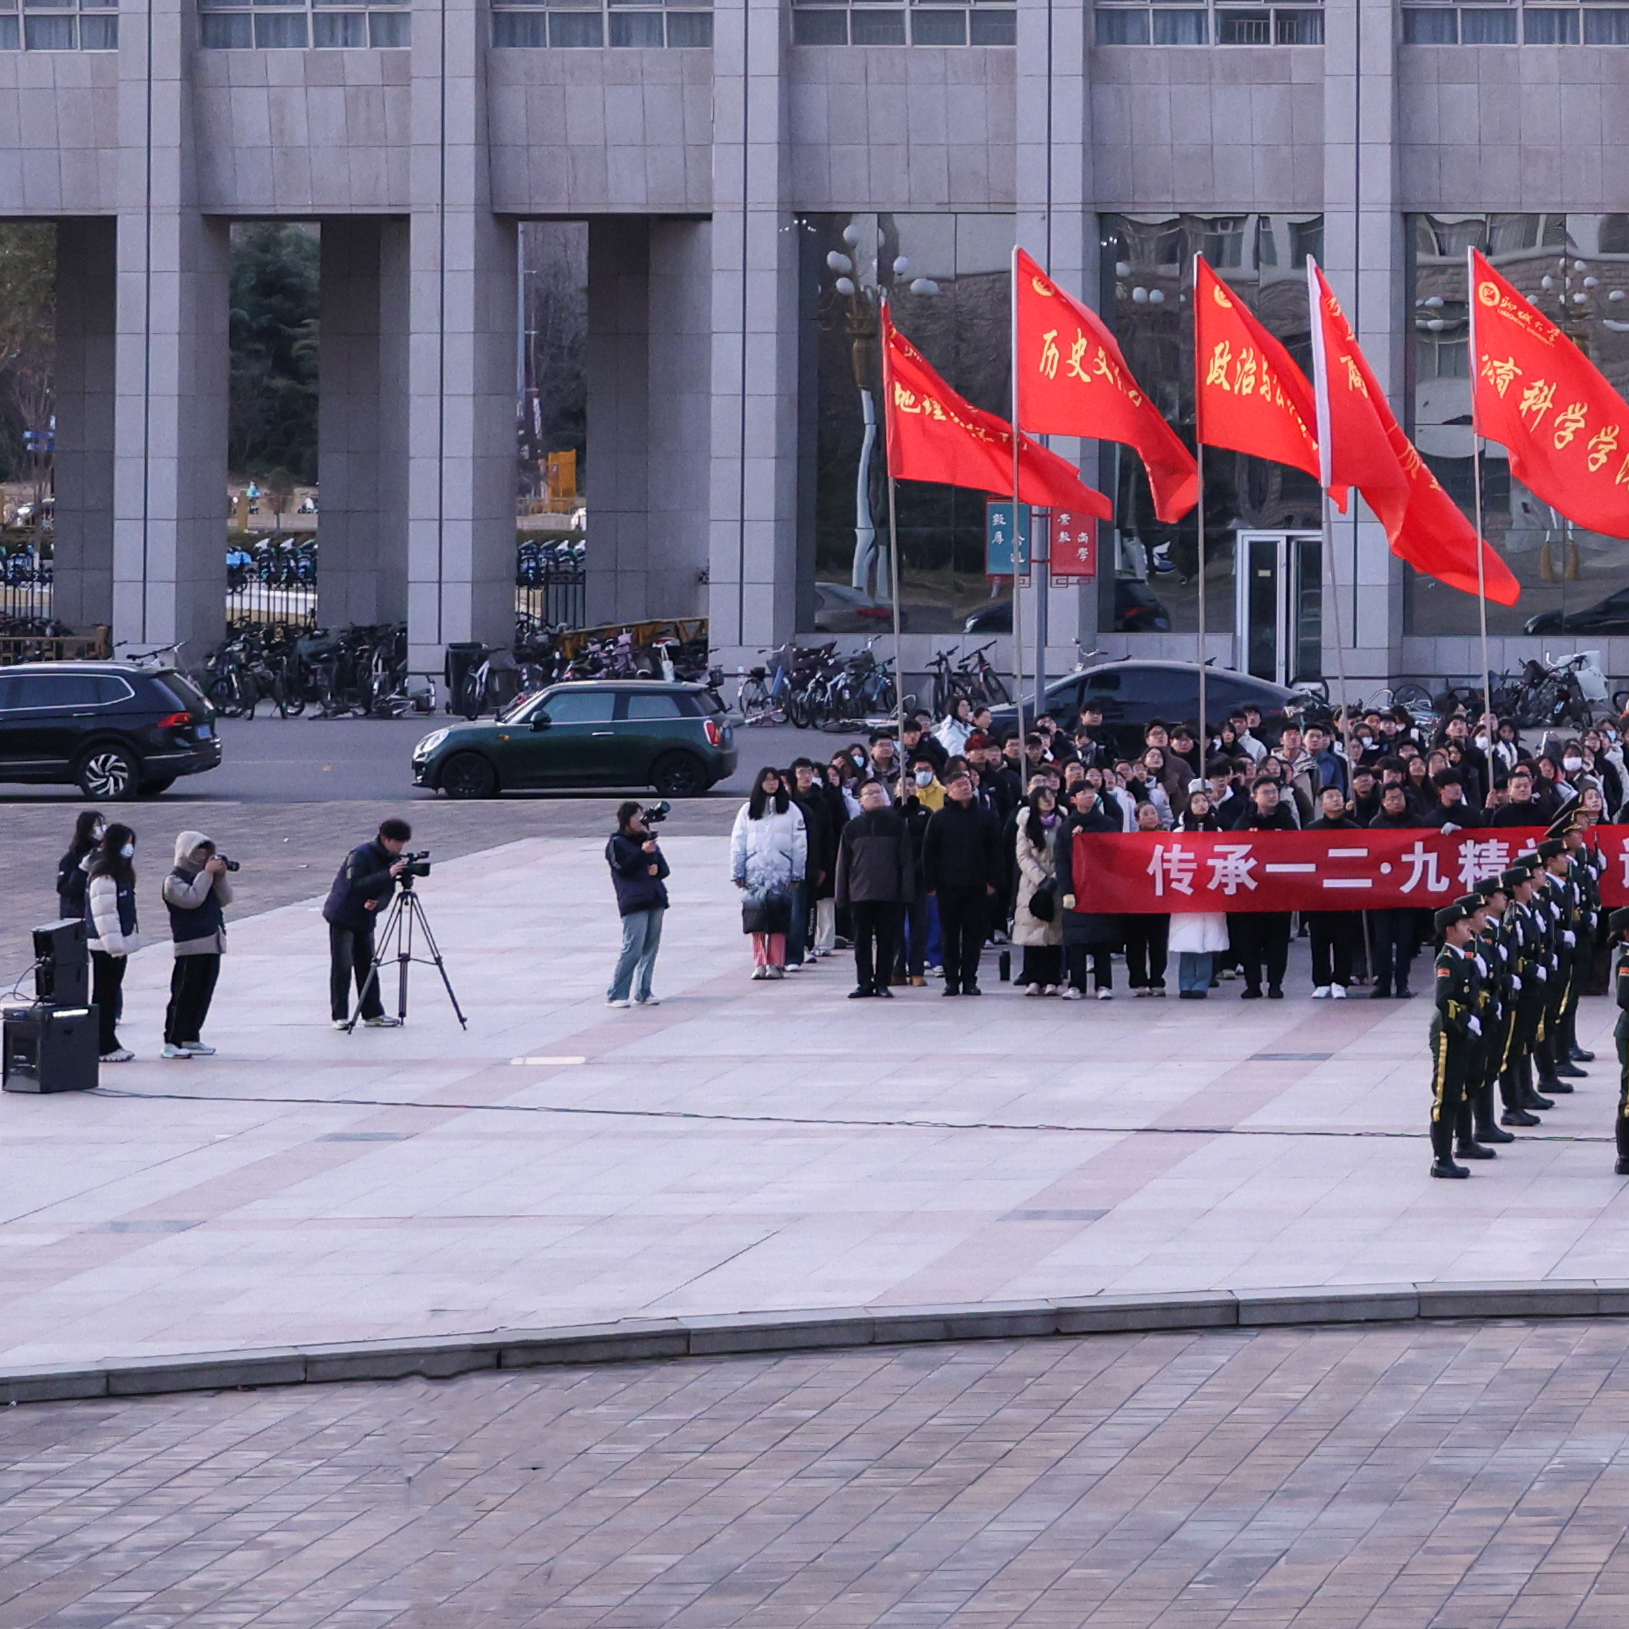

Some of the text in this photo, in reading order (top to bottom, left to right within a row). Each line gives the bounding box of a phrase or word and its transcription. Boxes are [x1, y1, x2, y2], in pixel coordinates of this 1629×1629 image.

[1146, 837, 1542, 898] 传承一二·九精
